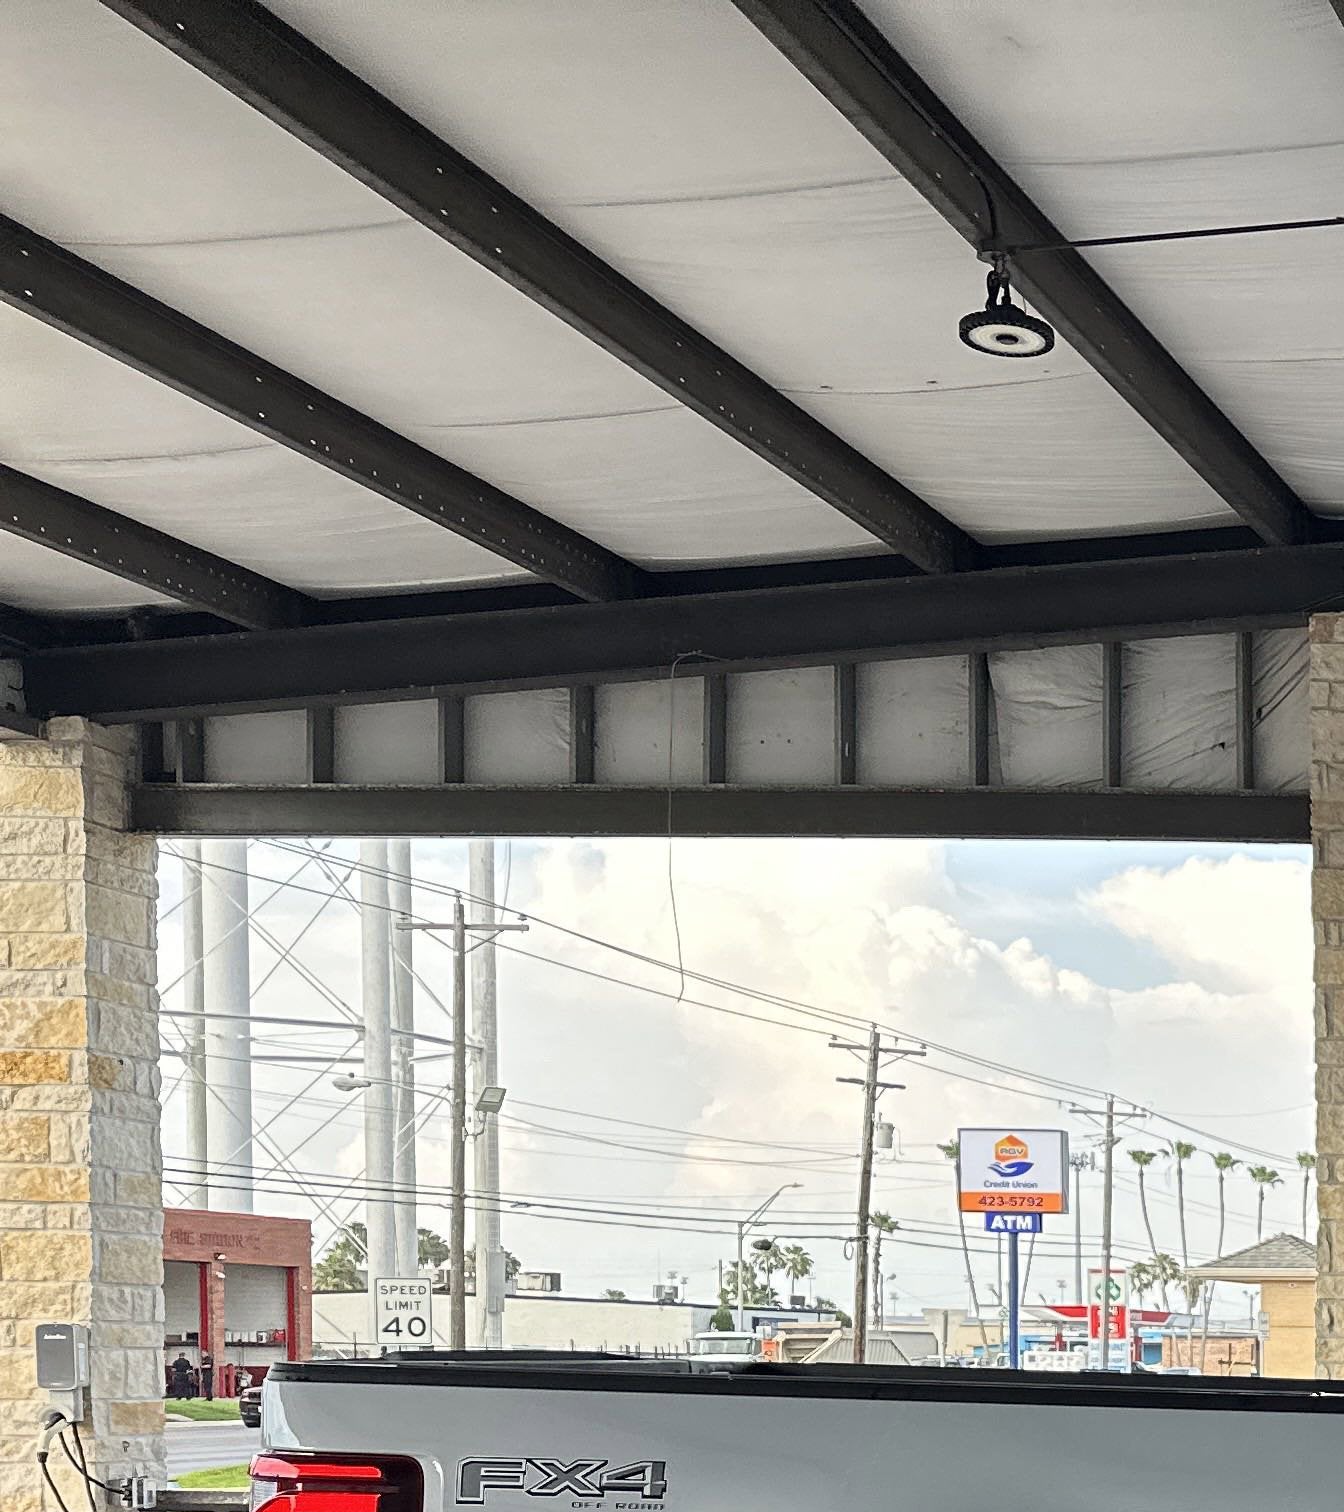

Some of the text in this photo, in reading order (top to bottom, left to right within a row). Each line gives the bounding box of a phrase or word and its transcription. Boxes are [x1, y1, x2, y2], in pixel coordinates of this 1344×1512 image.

[983, 1180, 1039, 1189] Credit Union
[979, 1195, 1044, 1207] 423-5792
[990, 1215, 1033, 1230] ATM
[380, 1285, 427, 1295] SPEED
[385, 1300, 422, 1311] LIMIT
[382, 1316, 427, 1337] 40
[455, 1457, 667, 1505] FX4
[571, 1501, 609, 1509] OFF
